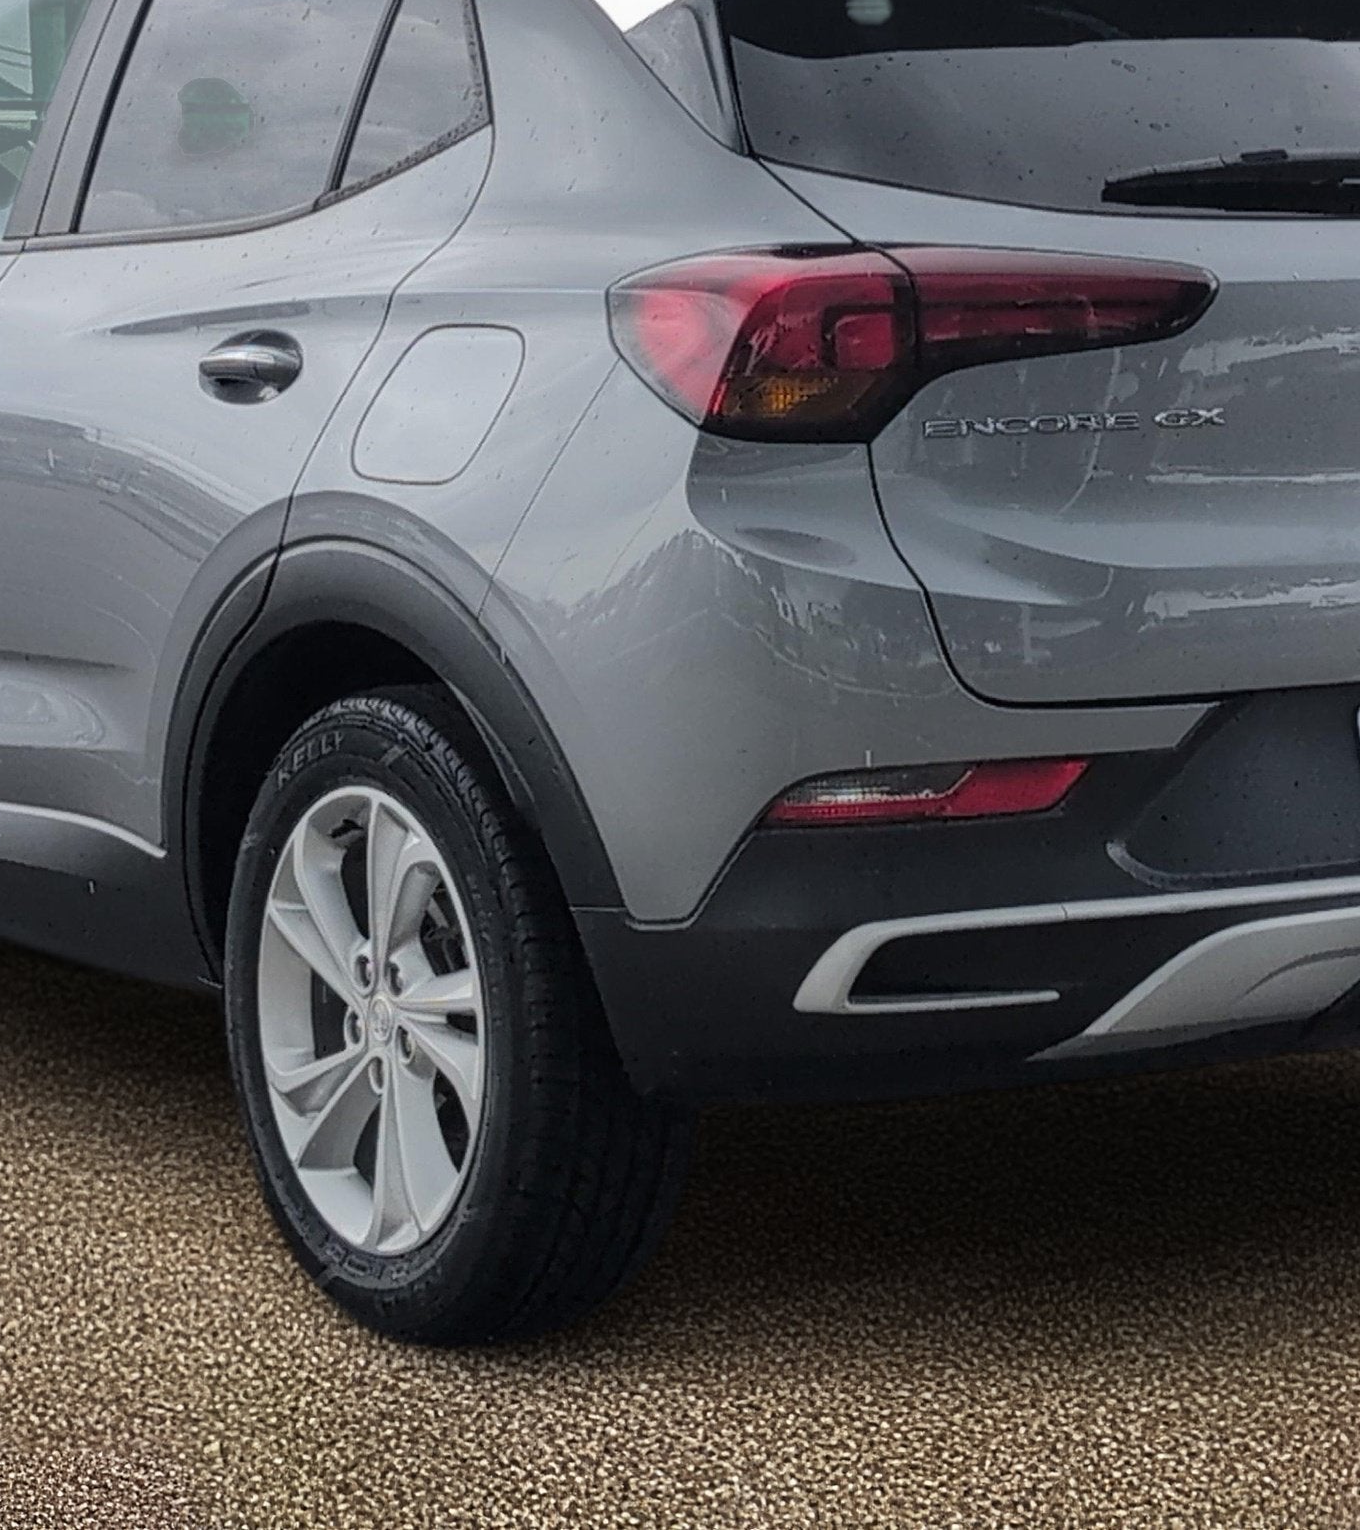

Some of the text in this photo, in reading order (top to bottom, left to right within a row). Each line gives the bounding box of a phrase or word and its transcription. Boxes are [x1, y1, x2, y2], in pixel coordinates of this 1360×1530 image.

[922, 407, 1227, 439] ENCORE GX
[277, 730, 344, 791] KELLY
